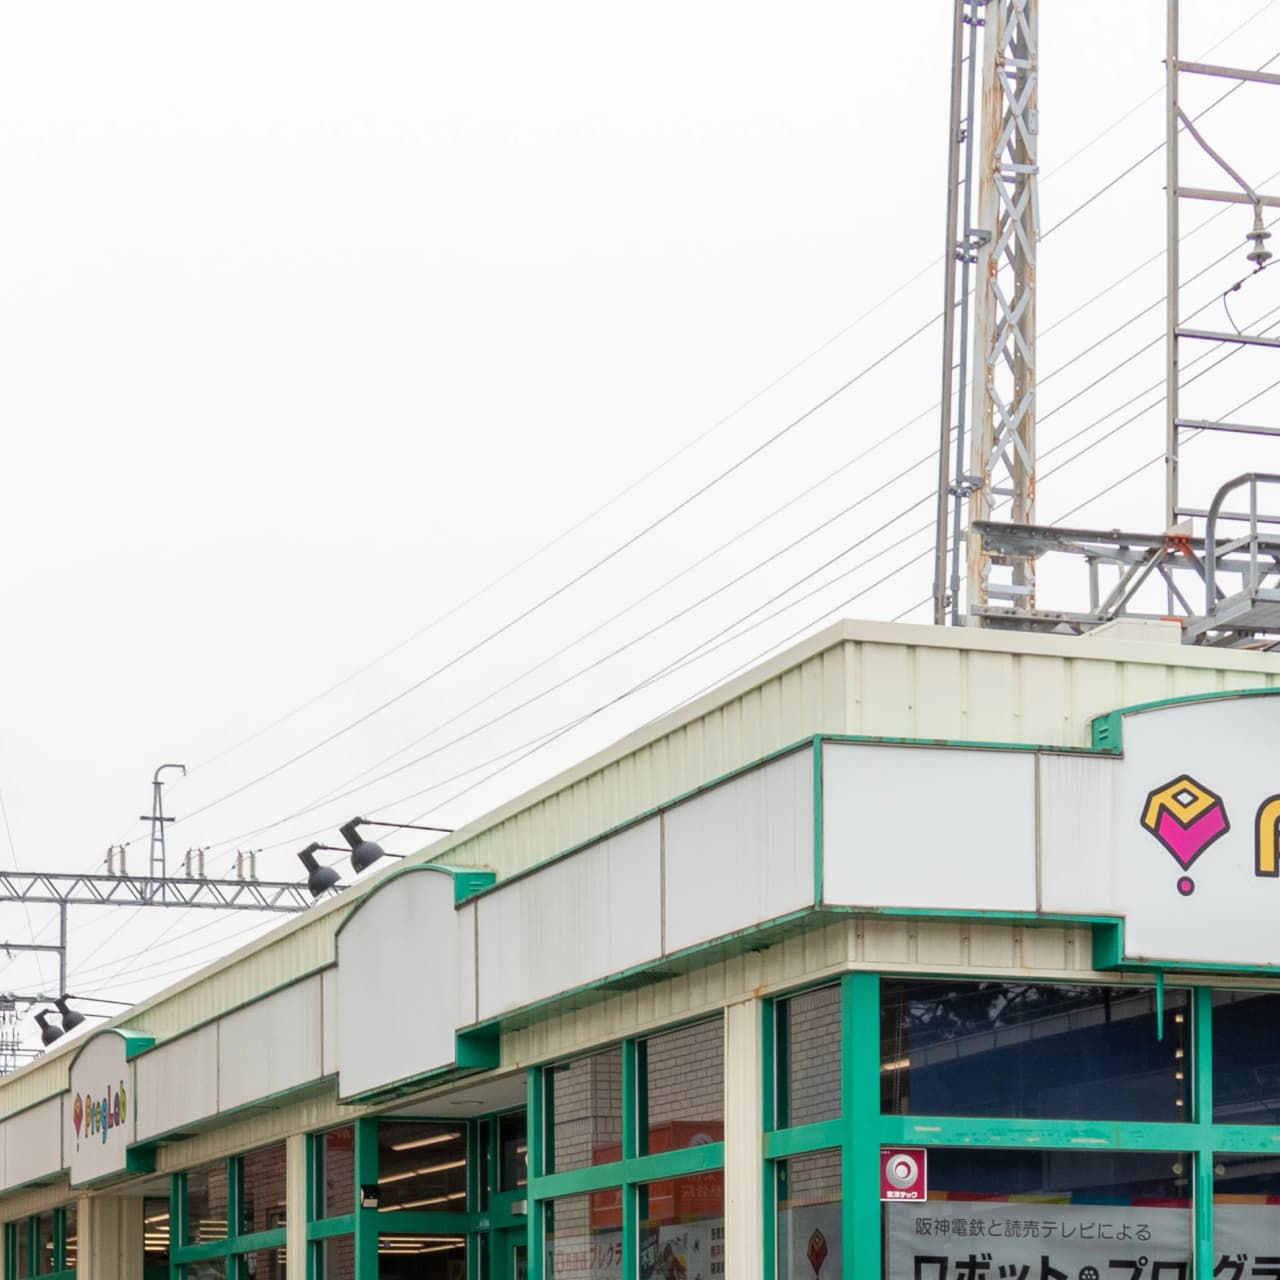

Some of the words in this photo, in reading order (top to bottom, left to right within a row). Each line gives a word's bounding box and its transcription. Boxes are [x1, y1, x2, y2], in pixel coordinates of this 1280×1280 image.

[84, 1080, 127, 1145] ProgLab
[915, 1218, 1152, 1241] 阪神電鉄と読売テレビによる
